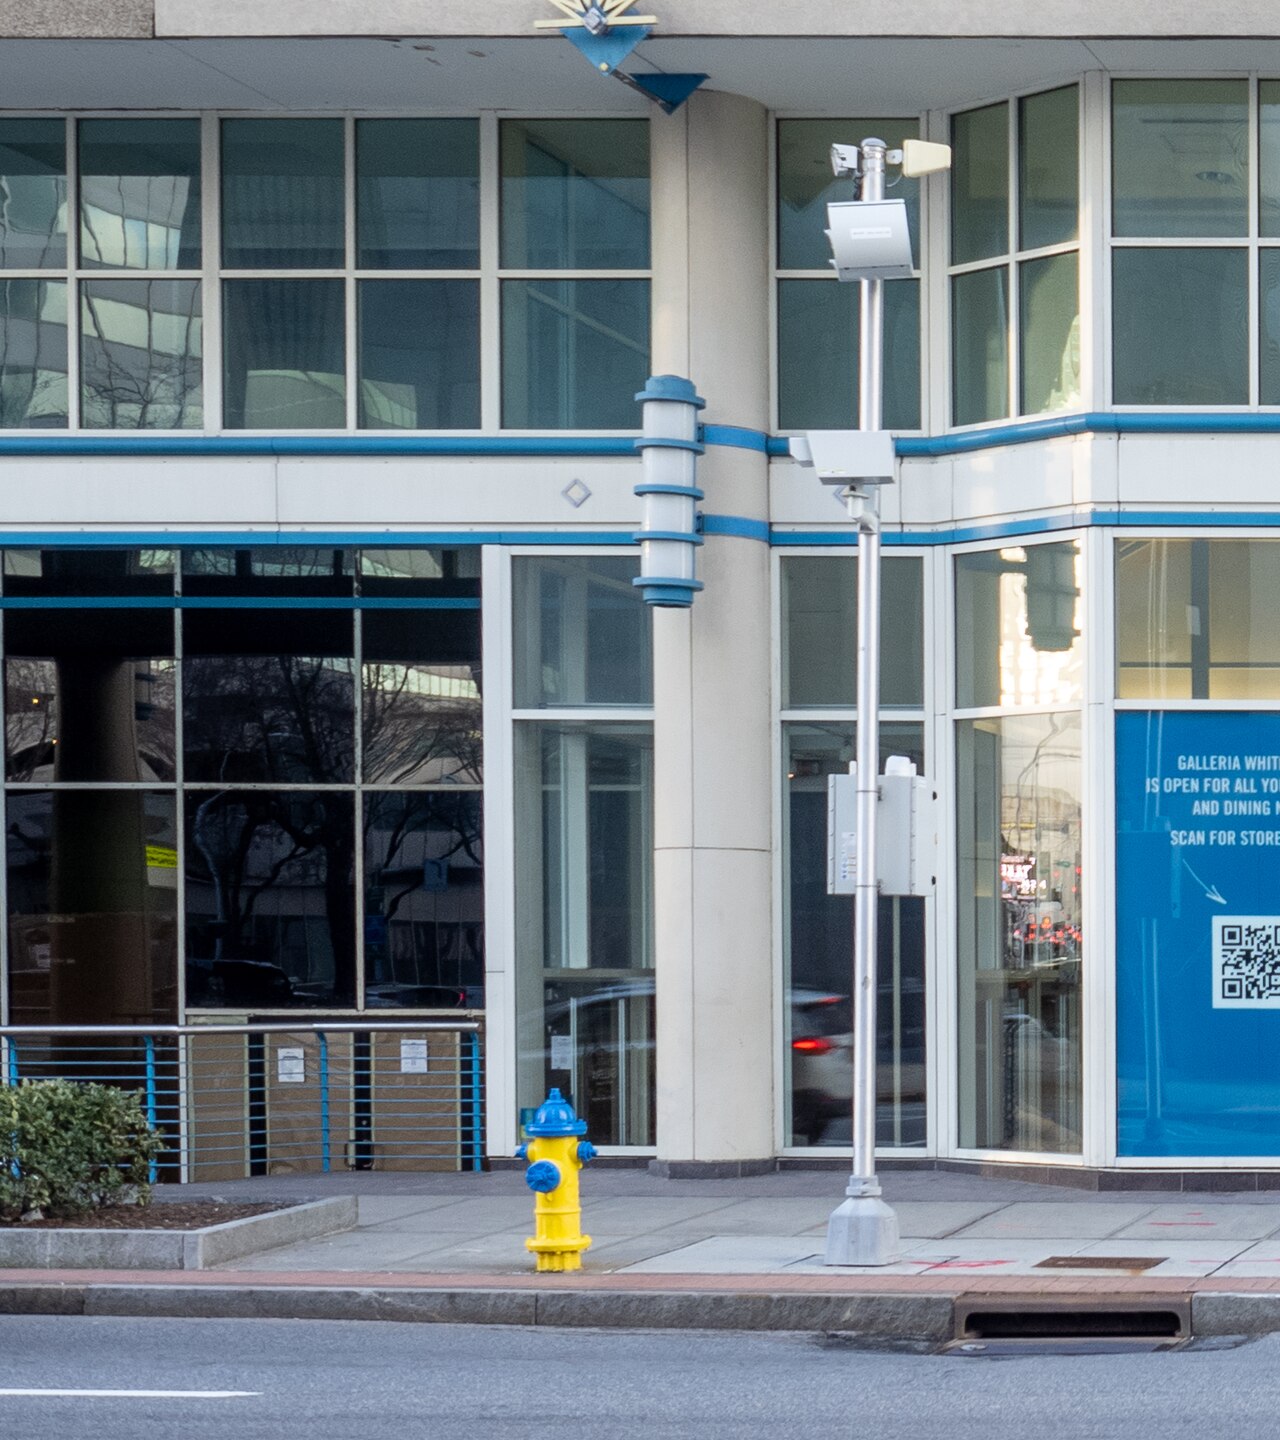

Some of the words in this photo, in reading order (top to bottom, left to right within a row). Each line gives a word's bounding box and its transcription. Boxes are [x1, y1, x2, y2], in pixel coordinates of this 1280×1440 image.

[1178, 755, 1241, 771] GALLERIA
[1146, 778, 1160, 793] IS
[1164, 778, 1199, 793] OPEN
[1204, 778, 1230, 793] FOR
[1234, 778, 1257, 793] ALL
[1192, 800, 1219, 815] AND
[1224, 800, 1271, 815] DINING
[1170, 830, 1205, 846] SCAN
[1209, 830, 1236, 846] FOR
[1240, 830, 1280, 846] STORE
